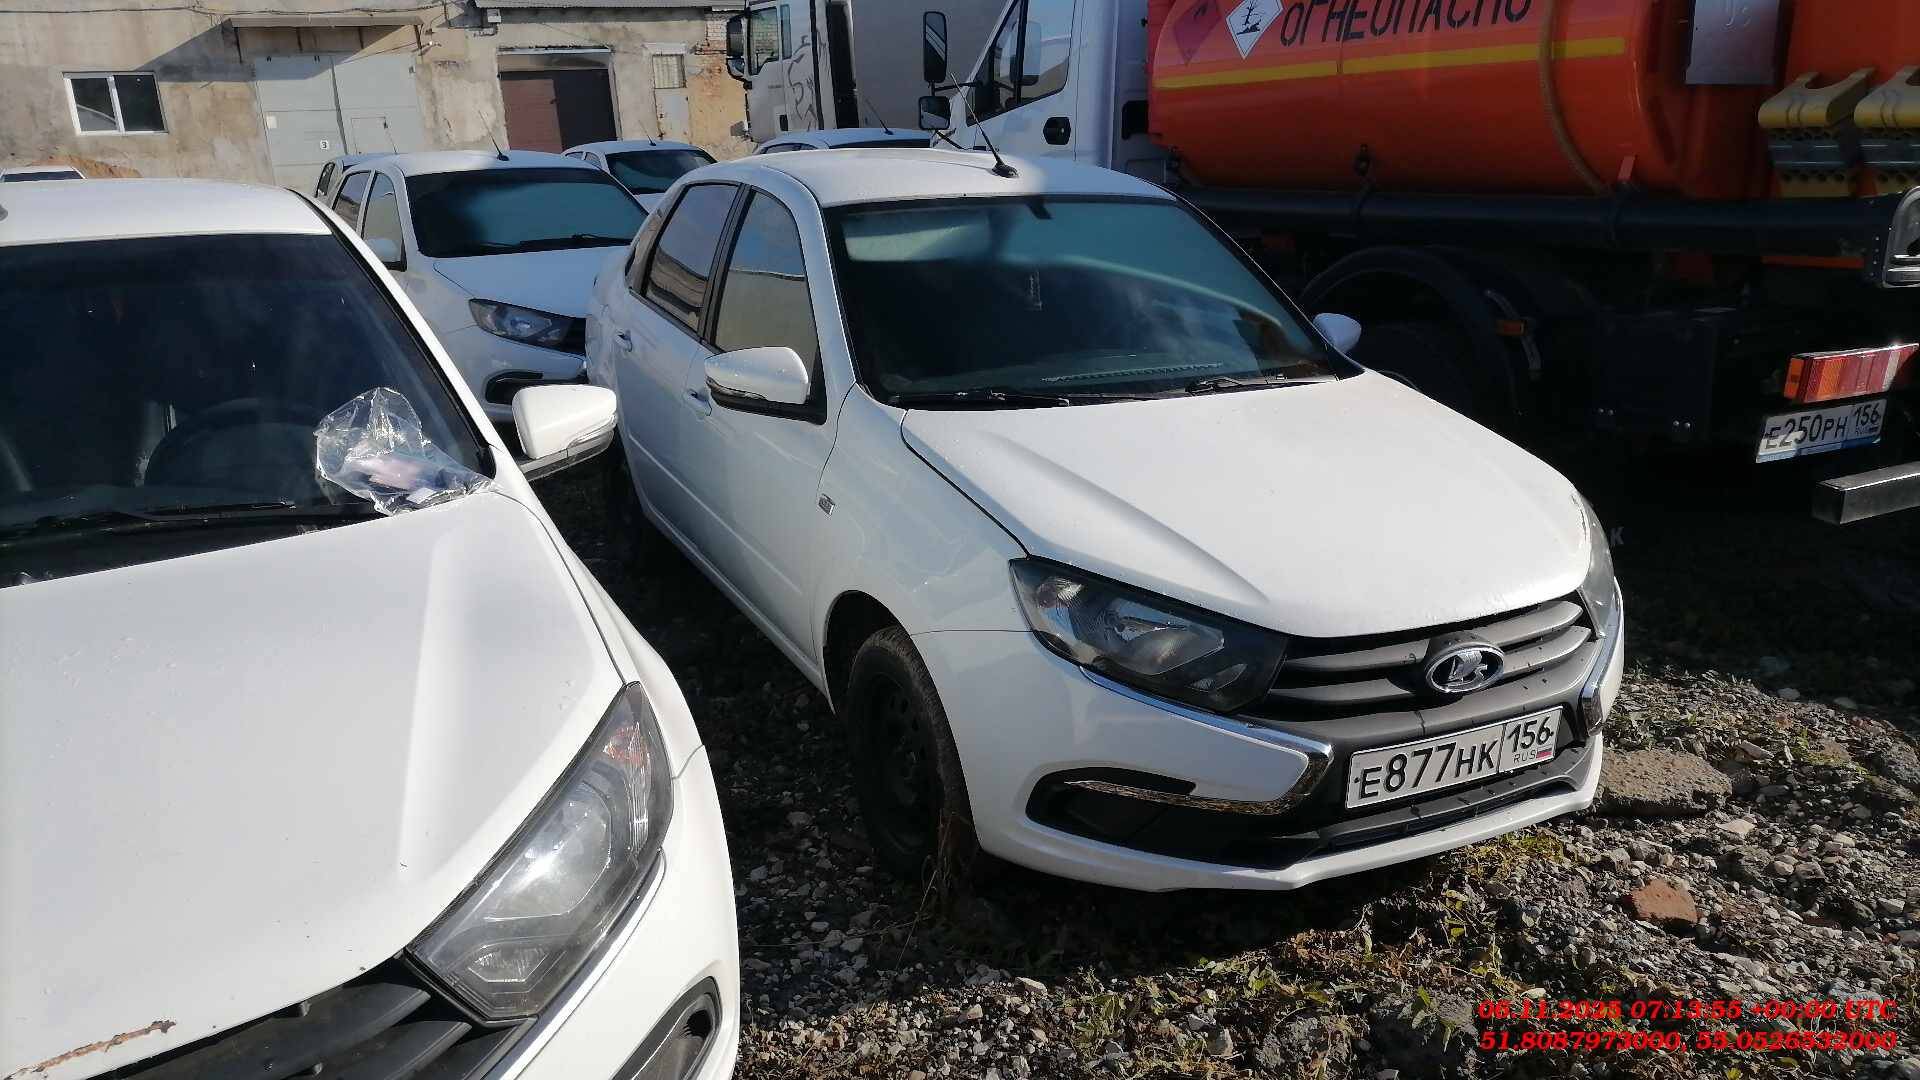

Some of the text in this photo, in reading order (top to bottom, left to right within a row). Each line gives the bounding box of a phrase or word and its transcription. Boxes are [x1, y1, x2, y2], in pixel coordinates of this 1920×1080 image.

[1855, 402, 1880, 427] 156
[1360, 716, 1551, 799] Е877НК 156
[1513, 749, 1536, 763] RUS
